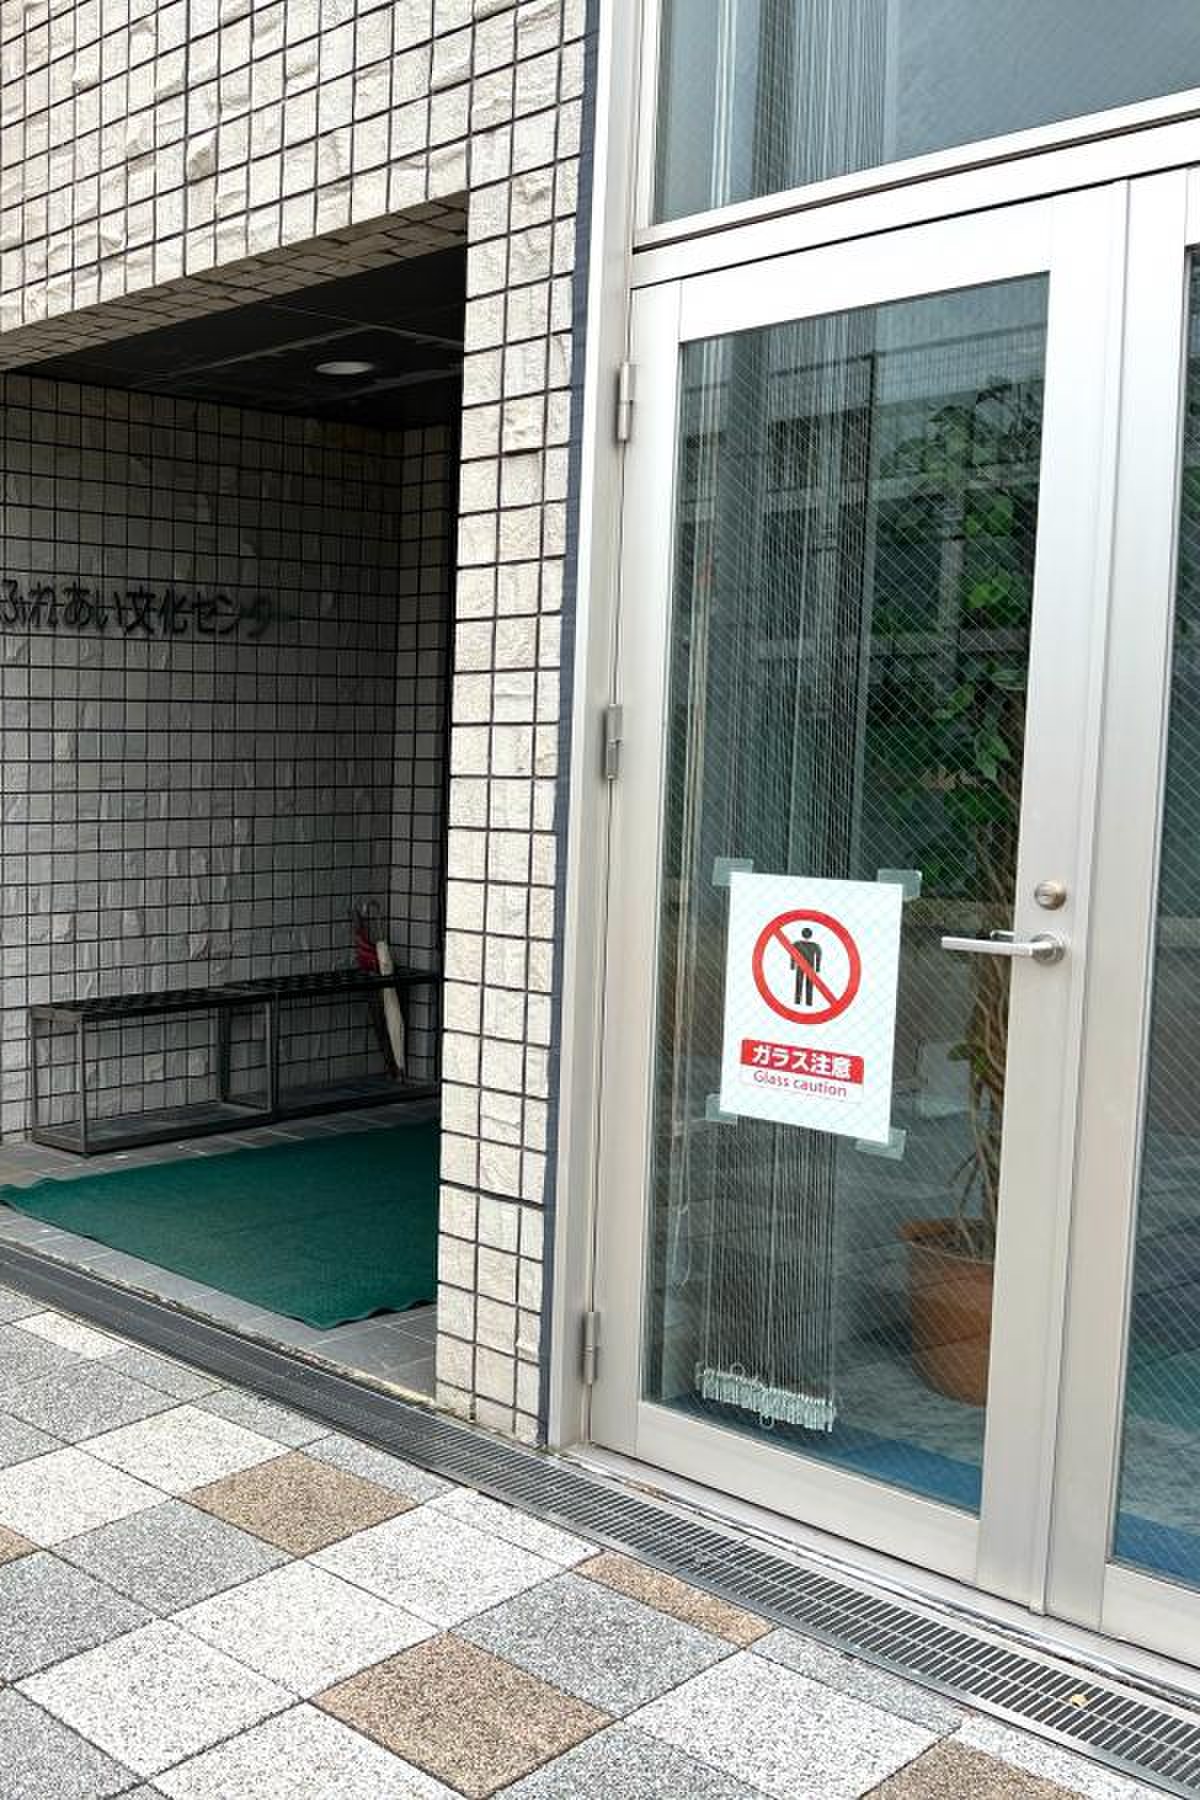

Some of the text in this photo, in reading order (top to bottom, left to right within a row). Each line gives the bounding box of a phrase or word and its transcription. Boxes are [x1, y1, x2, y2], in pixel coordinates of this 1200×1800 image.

[752, 1044, 853, 1079] ガラス注意
[753, 1069, 847, 1098] Glass caution
